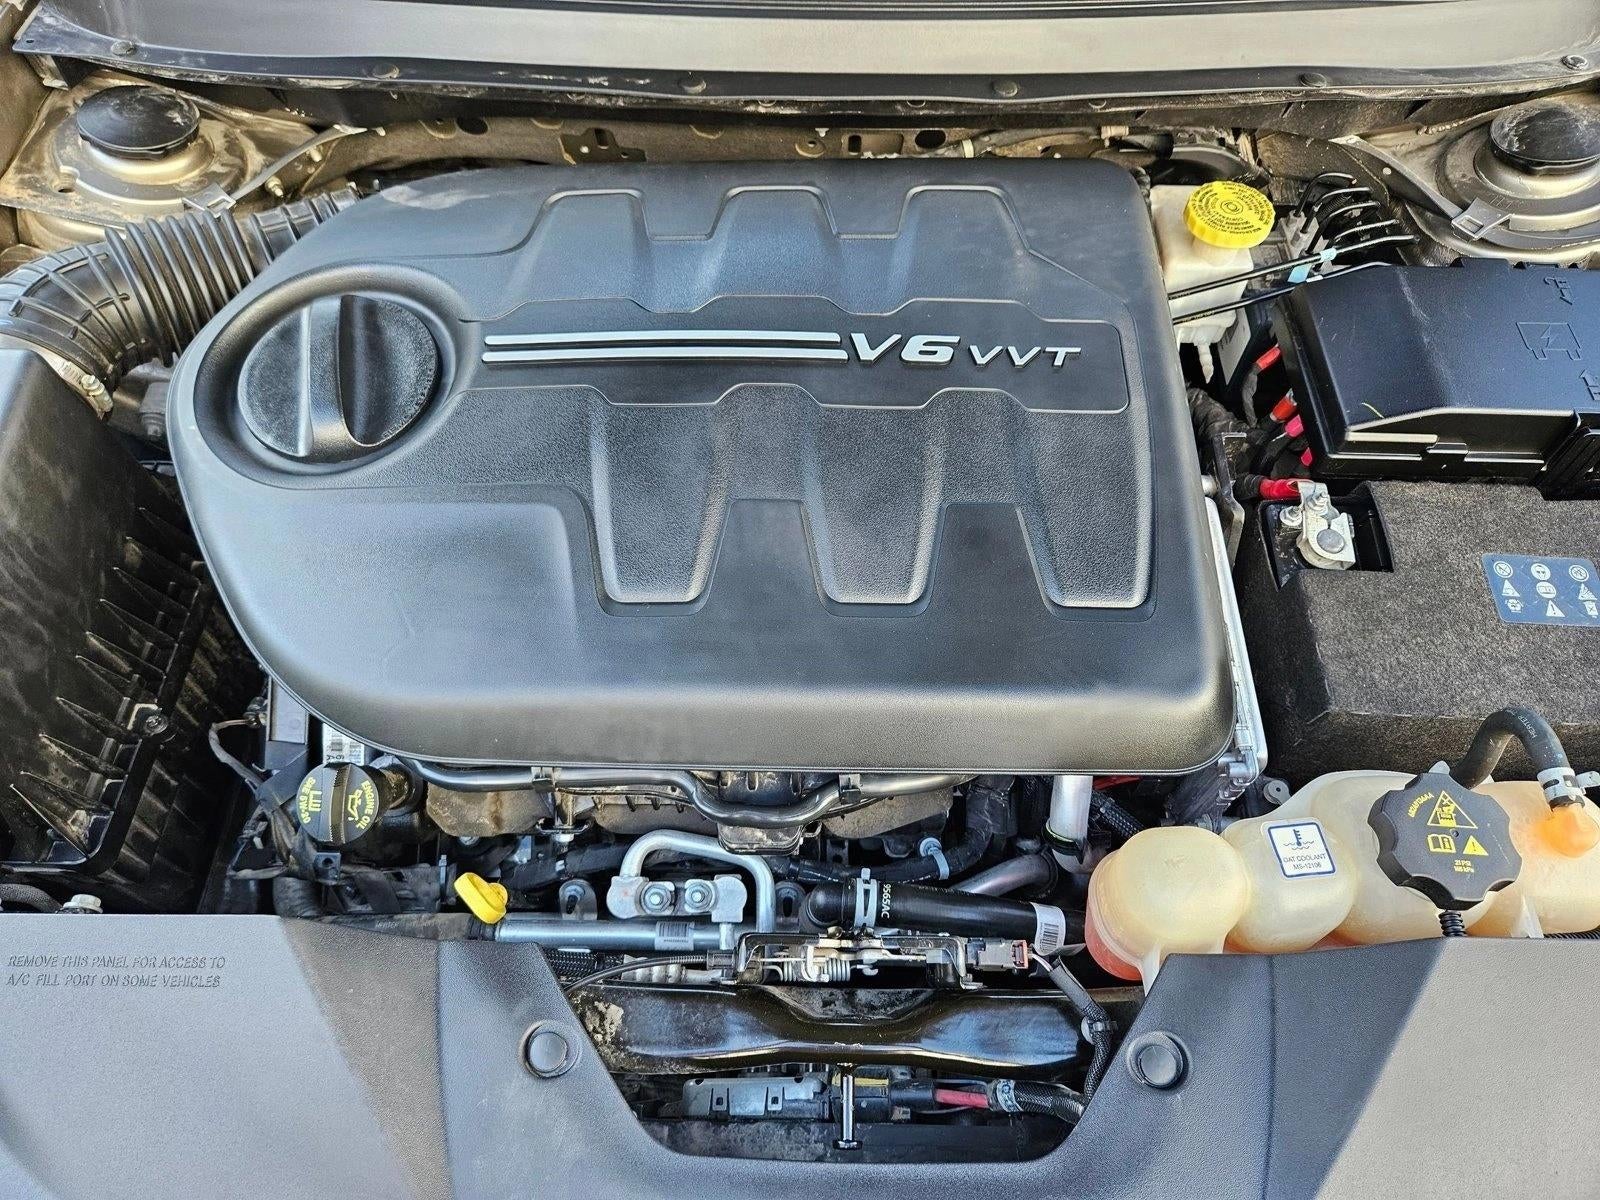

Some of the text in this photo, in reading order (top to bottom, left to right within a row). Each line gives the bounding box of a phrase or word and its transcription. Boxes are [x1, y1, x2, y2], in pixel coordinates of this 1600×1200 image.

[849, 332, 1083, 369] V6 VVT
[301, 777, 316, 796] SAE
[356, 780, 375, 830] ENGINE OIL
[1296, 854, 1326, 862] COOLANT
[881, 883, 891, 919] 9565AC
[7, 955, 226, 969] REMOVE THIS PANEL FOR ACCESS TO
[6, 973, 221, 988] A/C FILL PORT ON SOME VEHICLES
